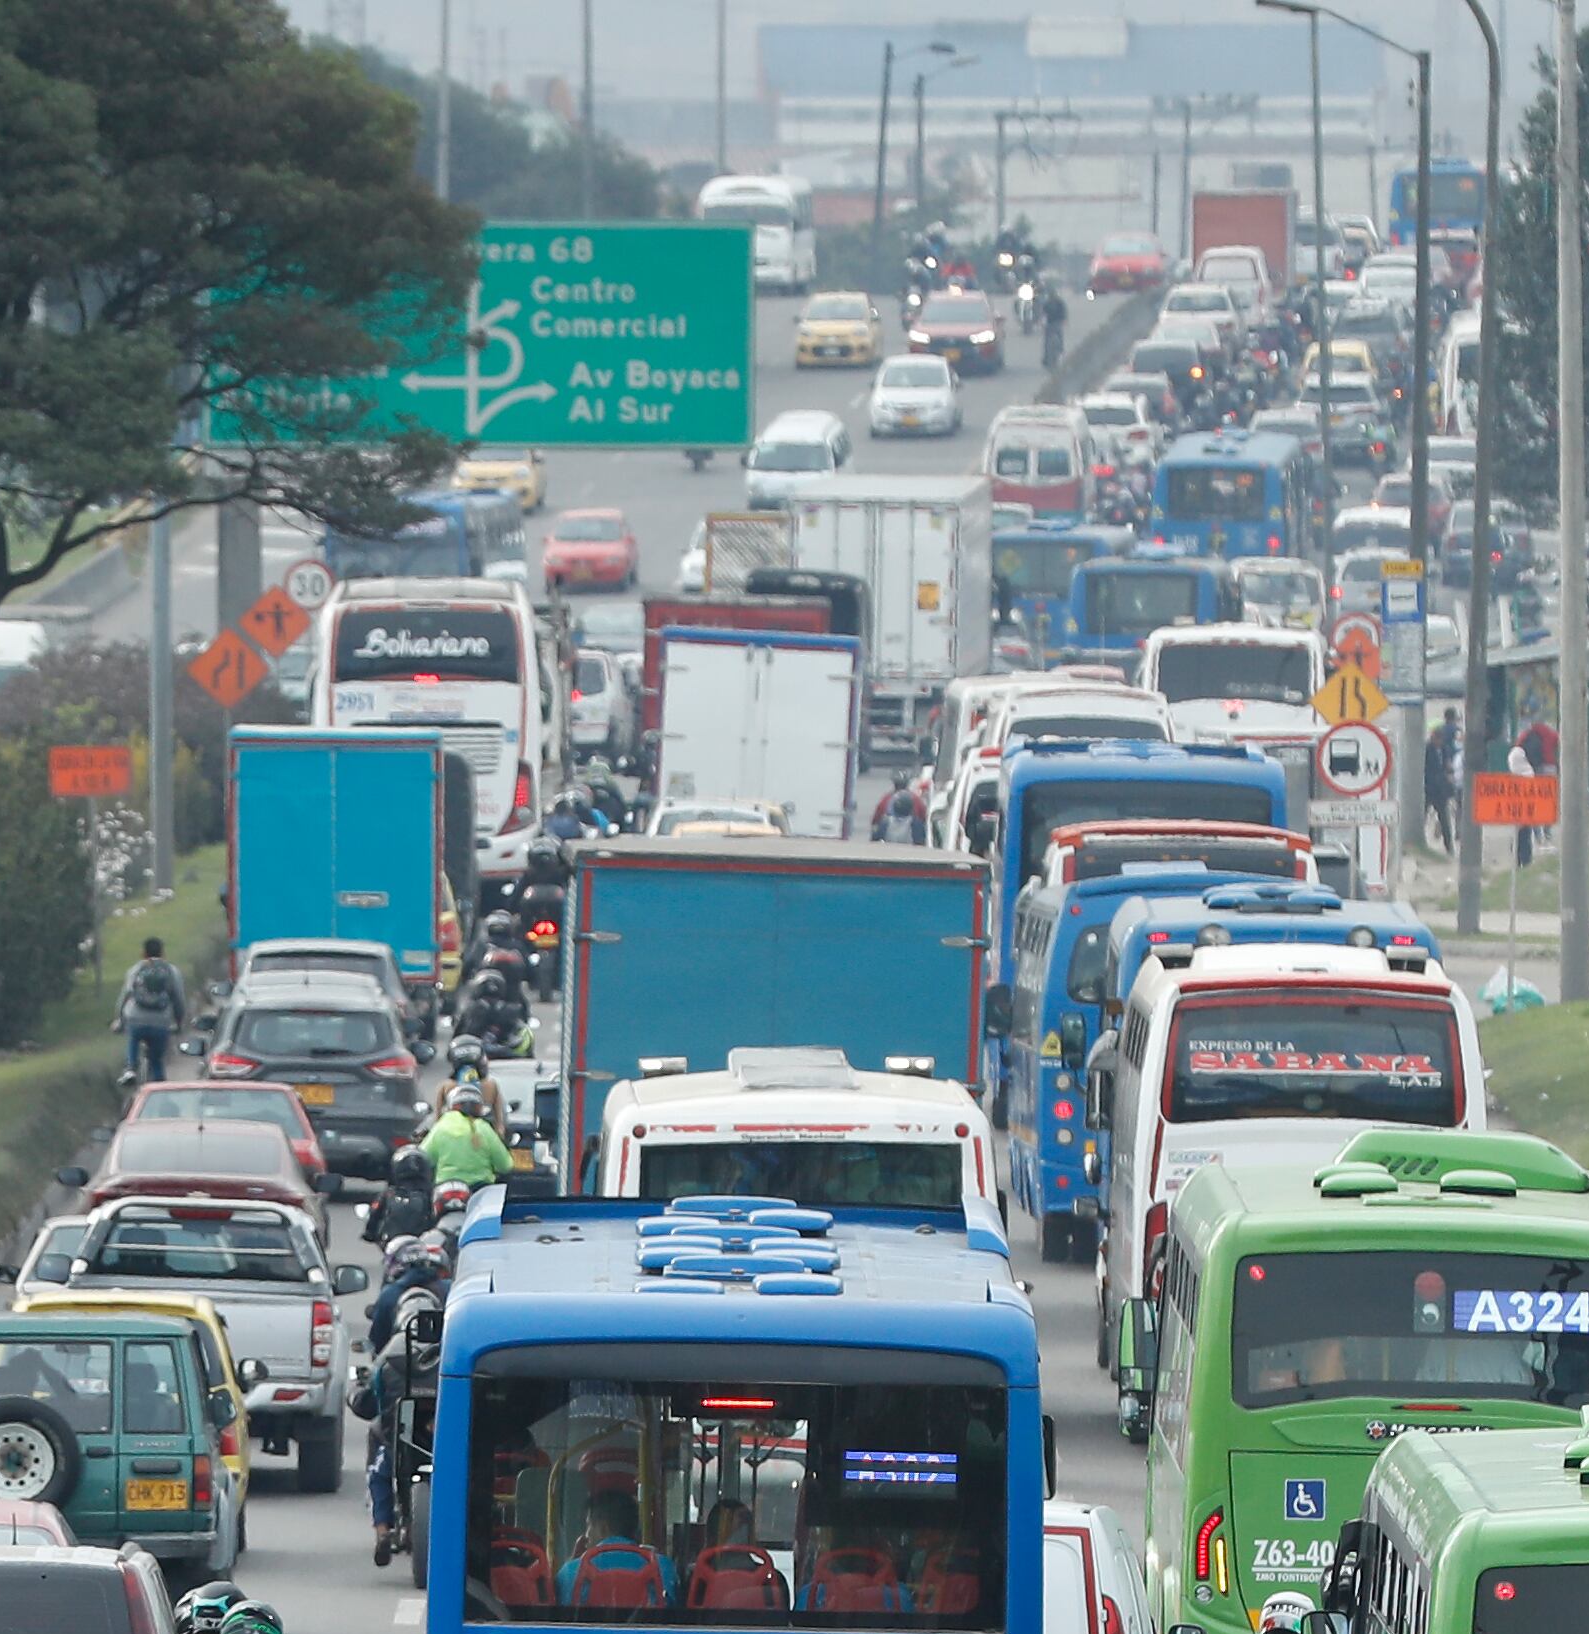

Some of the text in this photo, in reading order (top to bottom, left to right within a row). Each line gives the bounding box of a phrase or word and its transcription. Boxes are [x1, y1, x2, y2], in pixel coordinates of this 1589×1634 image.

[548, 236, 595, 263] 68
[530, 275, 637, 303] Centro
[530, 311, 688, 339] Comercial
[568, 361, 615, 389] Av
[568, 397, 673, 424] Al Sur
[296, 572, 325, 597] 30
[1188, 1040, 1295, 1051] EXPRESO DE LA
[1189, 1051, 1439, 1074] SABANA
